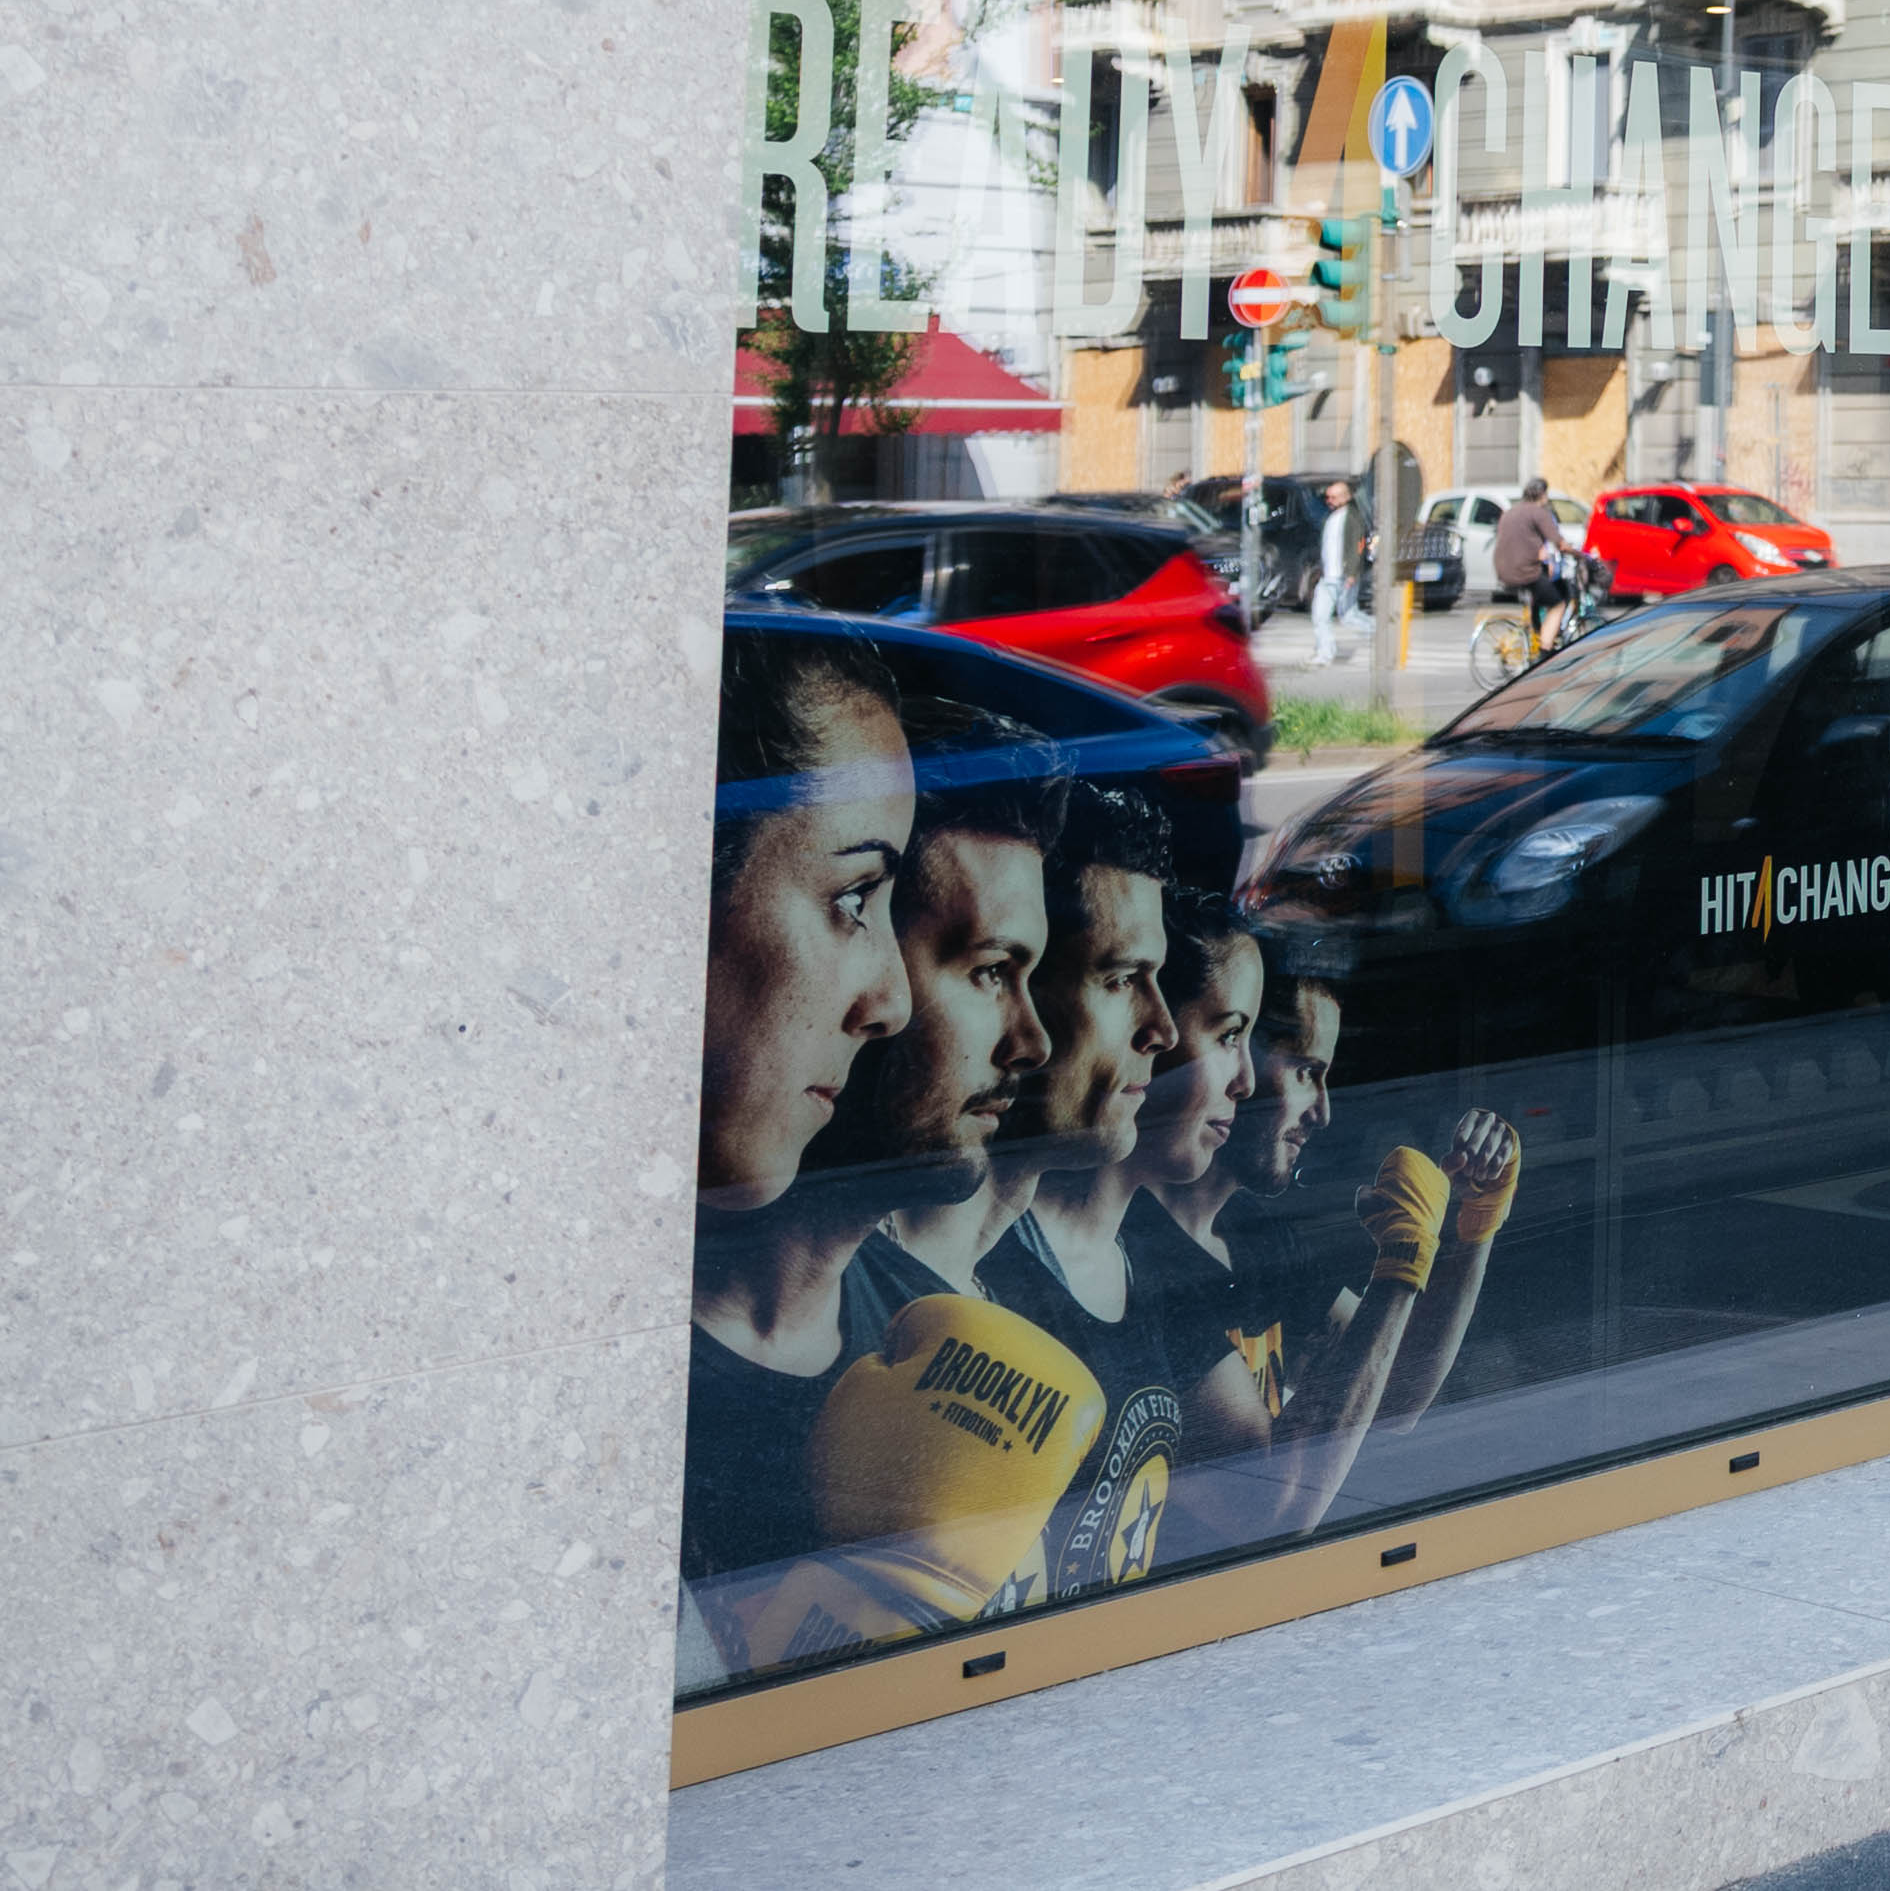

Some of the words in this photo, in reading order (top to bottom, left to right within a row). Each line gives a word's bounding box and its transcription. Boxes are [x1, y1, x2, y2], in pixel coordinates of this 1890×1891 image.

[913, 1336, 1070, 1455] BROOKLYN
[941, 1401, 1004, 1447] FITBOXING
[1070, 1397, 1149, 1551] BROOKLYN
